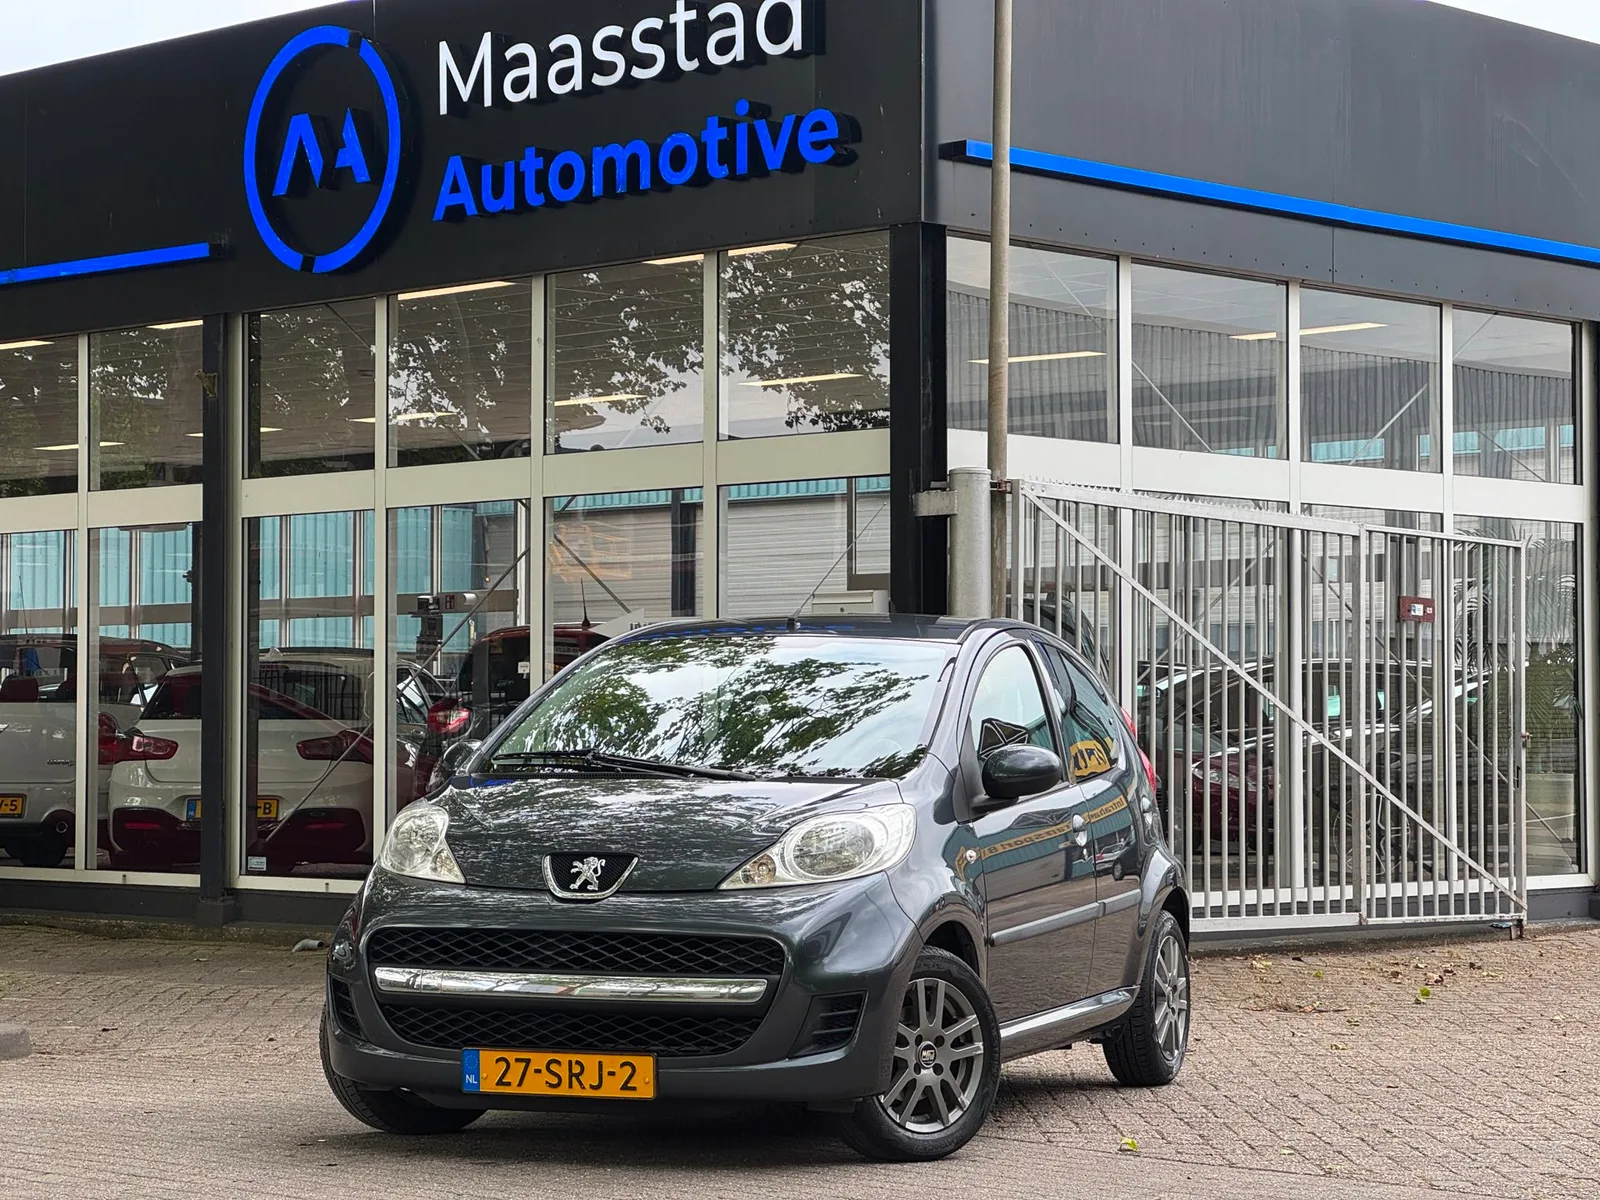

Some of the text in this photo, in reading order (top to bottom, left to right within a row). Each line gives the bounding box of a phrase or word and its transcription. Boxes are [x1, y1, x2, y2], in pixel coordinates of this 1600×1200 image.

[438, 0, 802, 115] Maasstad
[432, 98, 839, 221] Automotive
[465, 1073, 478, 1084] NL
[495, 1057, 637, 1091] 27-SRJ-2
